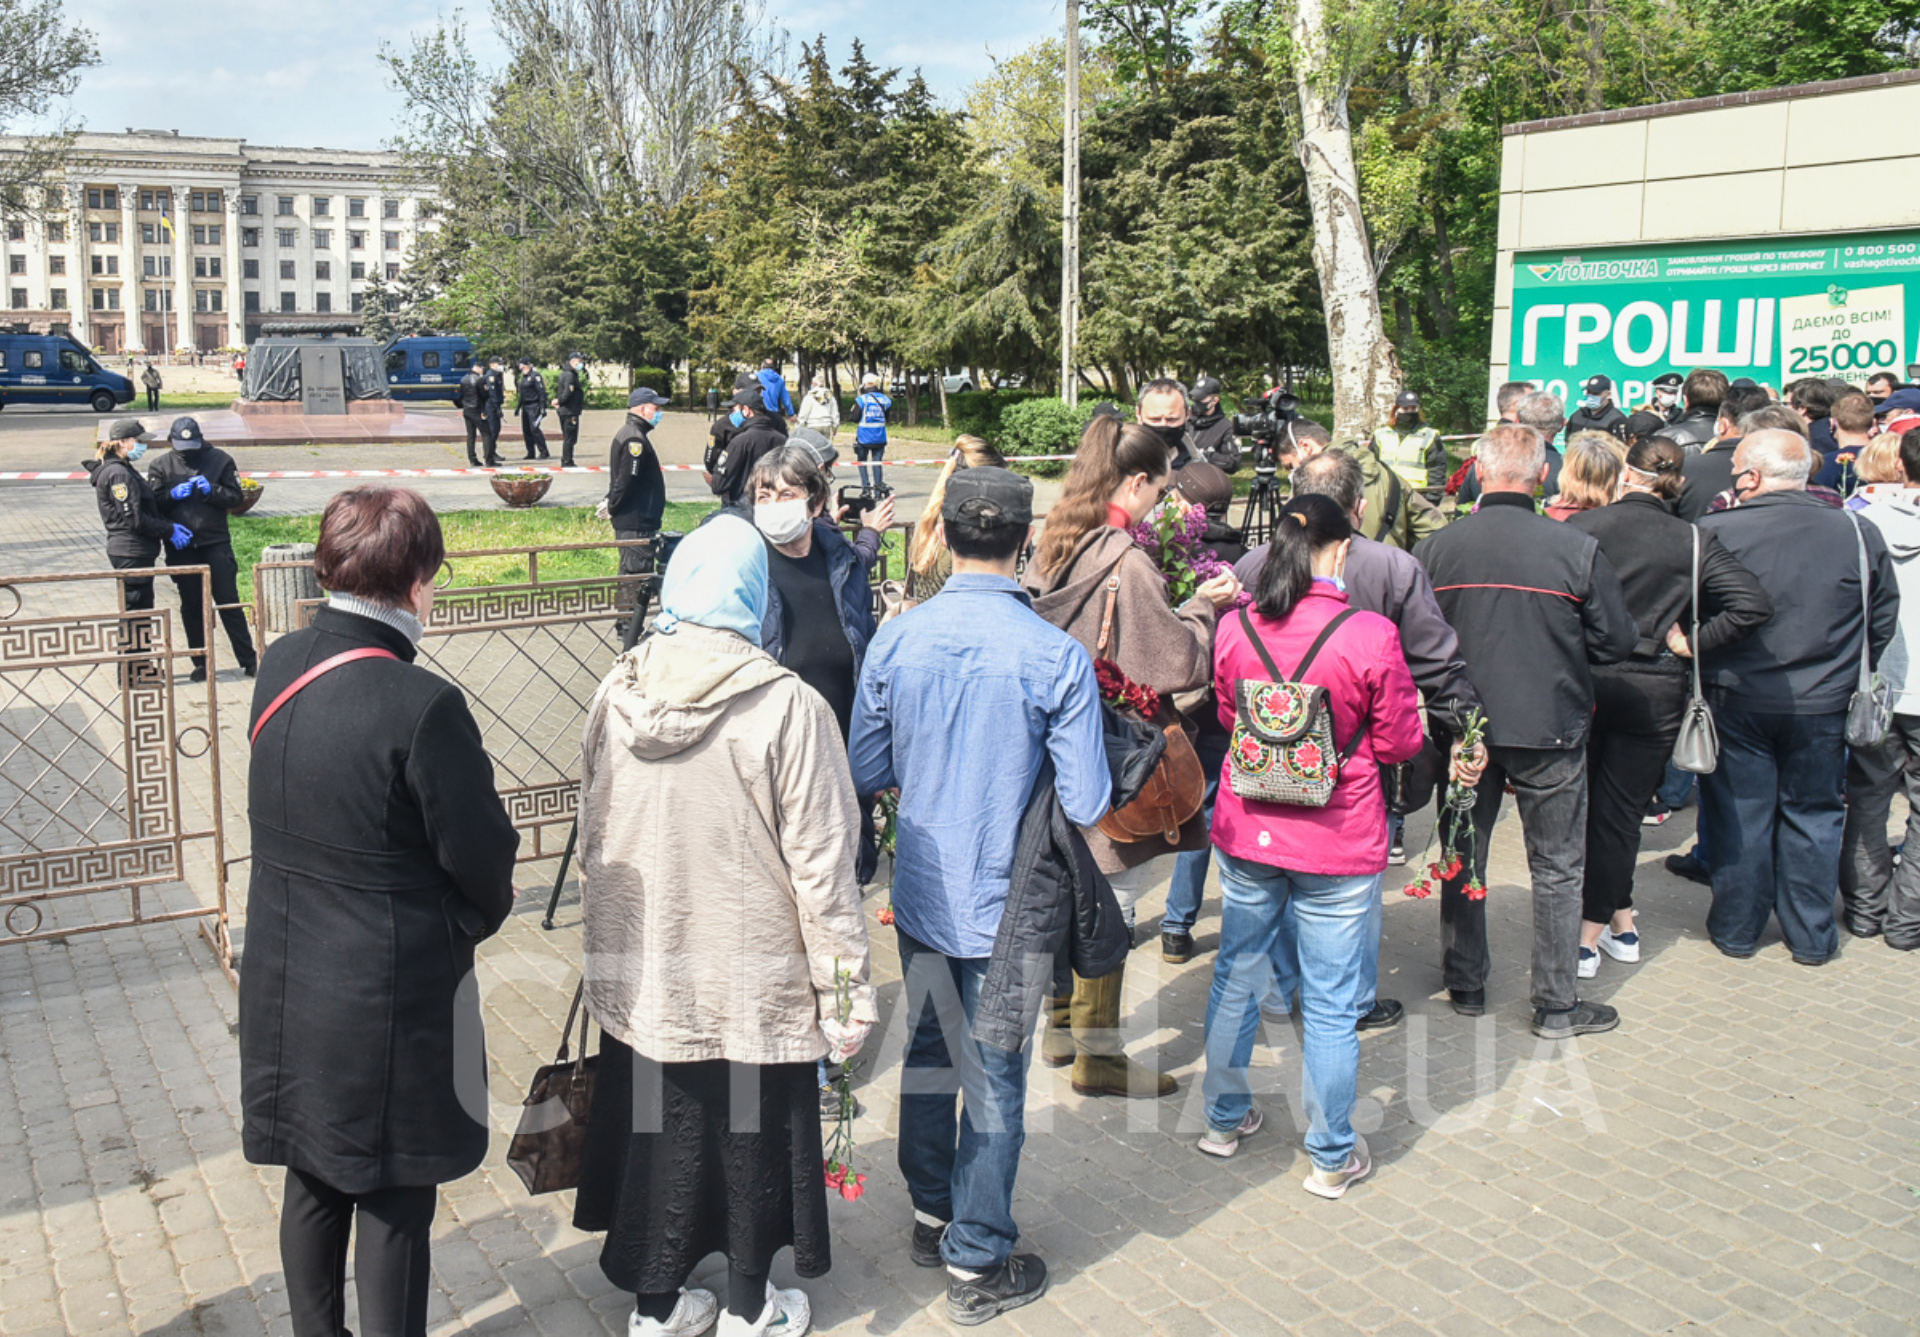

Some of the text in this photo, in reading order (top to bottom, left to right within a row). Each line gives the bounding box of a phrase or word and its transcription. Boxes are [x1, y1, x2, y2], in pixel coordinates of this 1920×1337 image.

[1778, 250, 1826, 259] ТЕЛЕФОНУ
[1844, 243, 1916, 256] 0 800 500
[1558, 258, 1658, 281] ГОТІВОЧКА
[1792, 310, 1892, 331] ДАЄМО ВСІМ!
[1521, 298, 1775, 367] ГРОШІ
[1831, 328, 1851, 341] ДО
[1789, 339, 1897, 374] 25000
